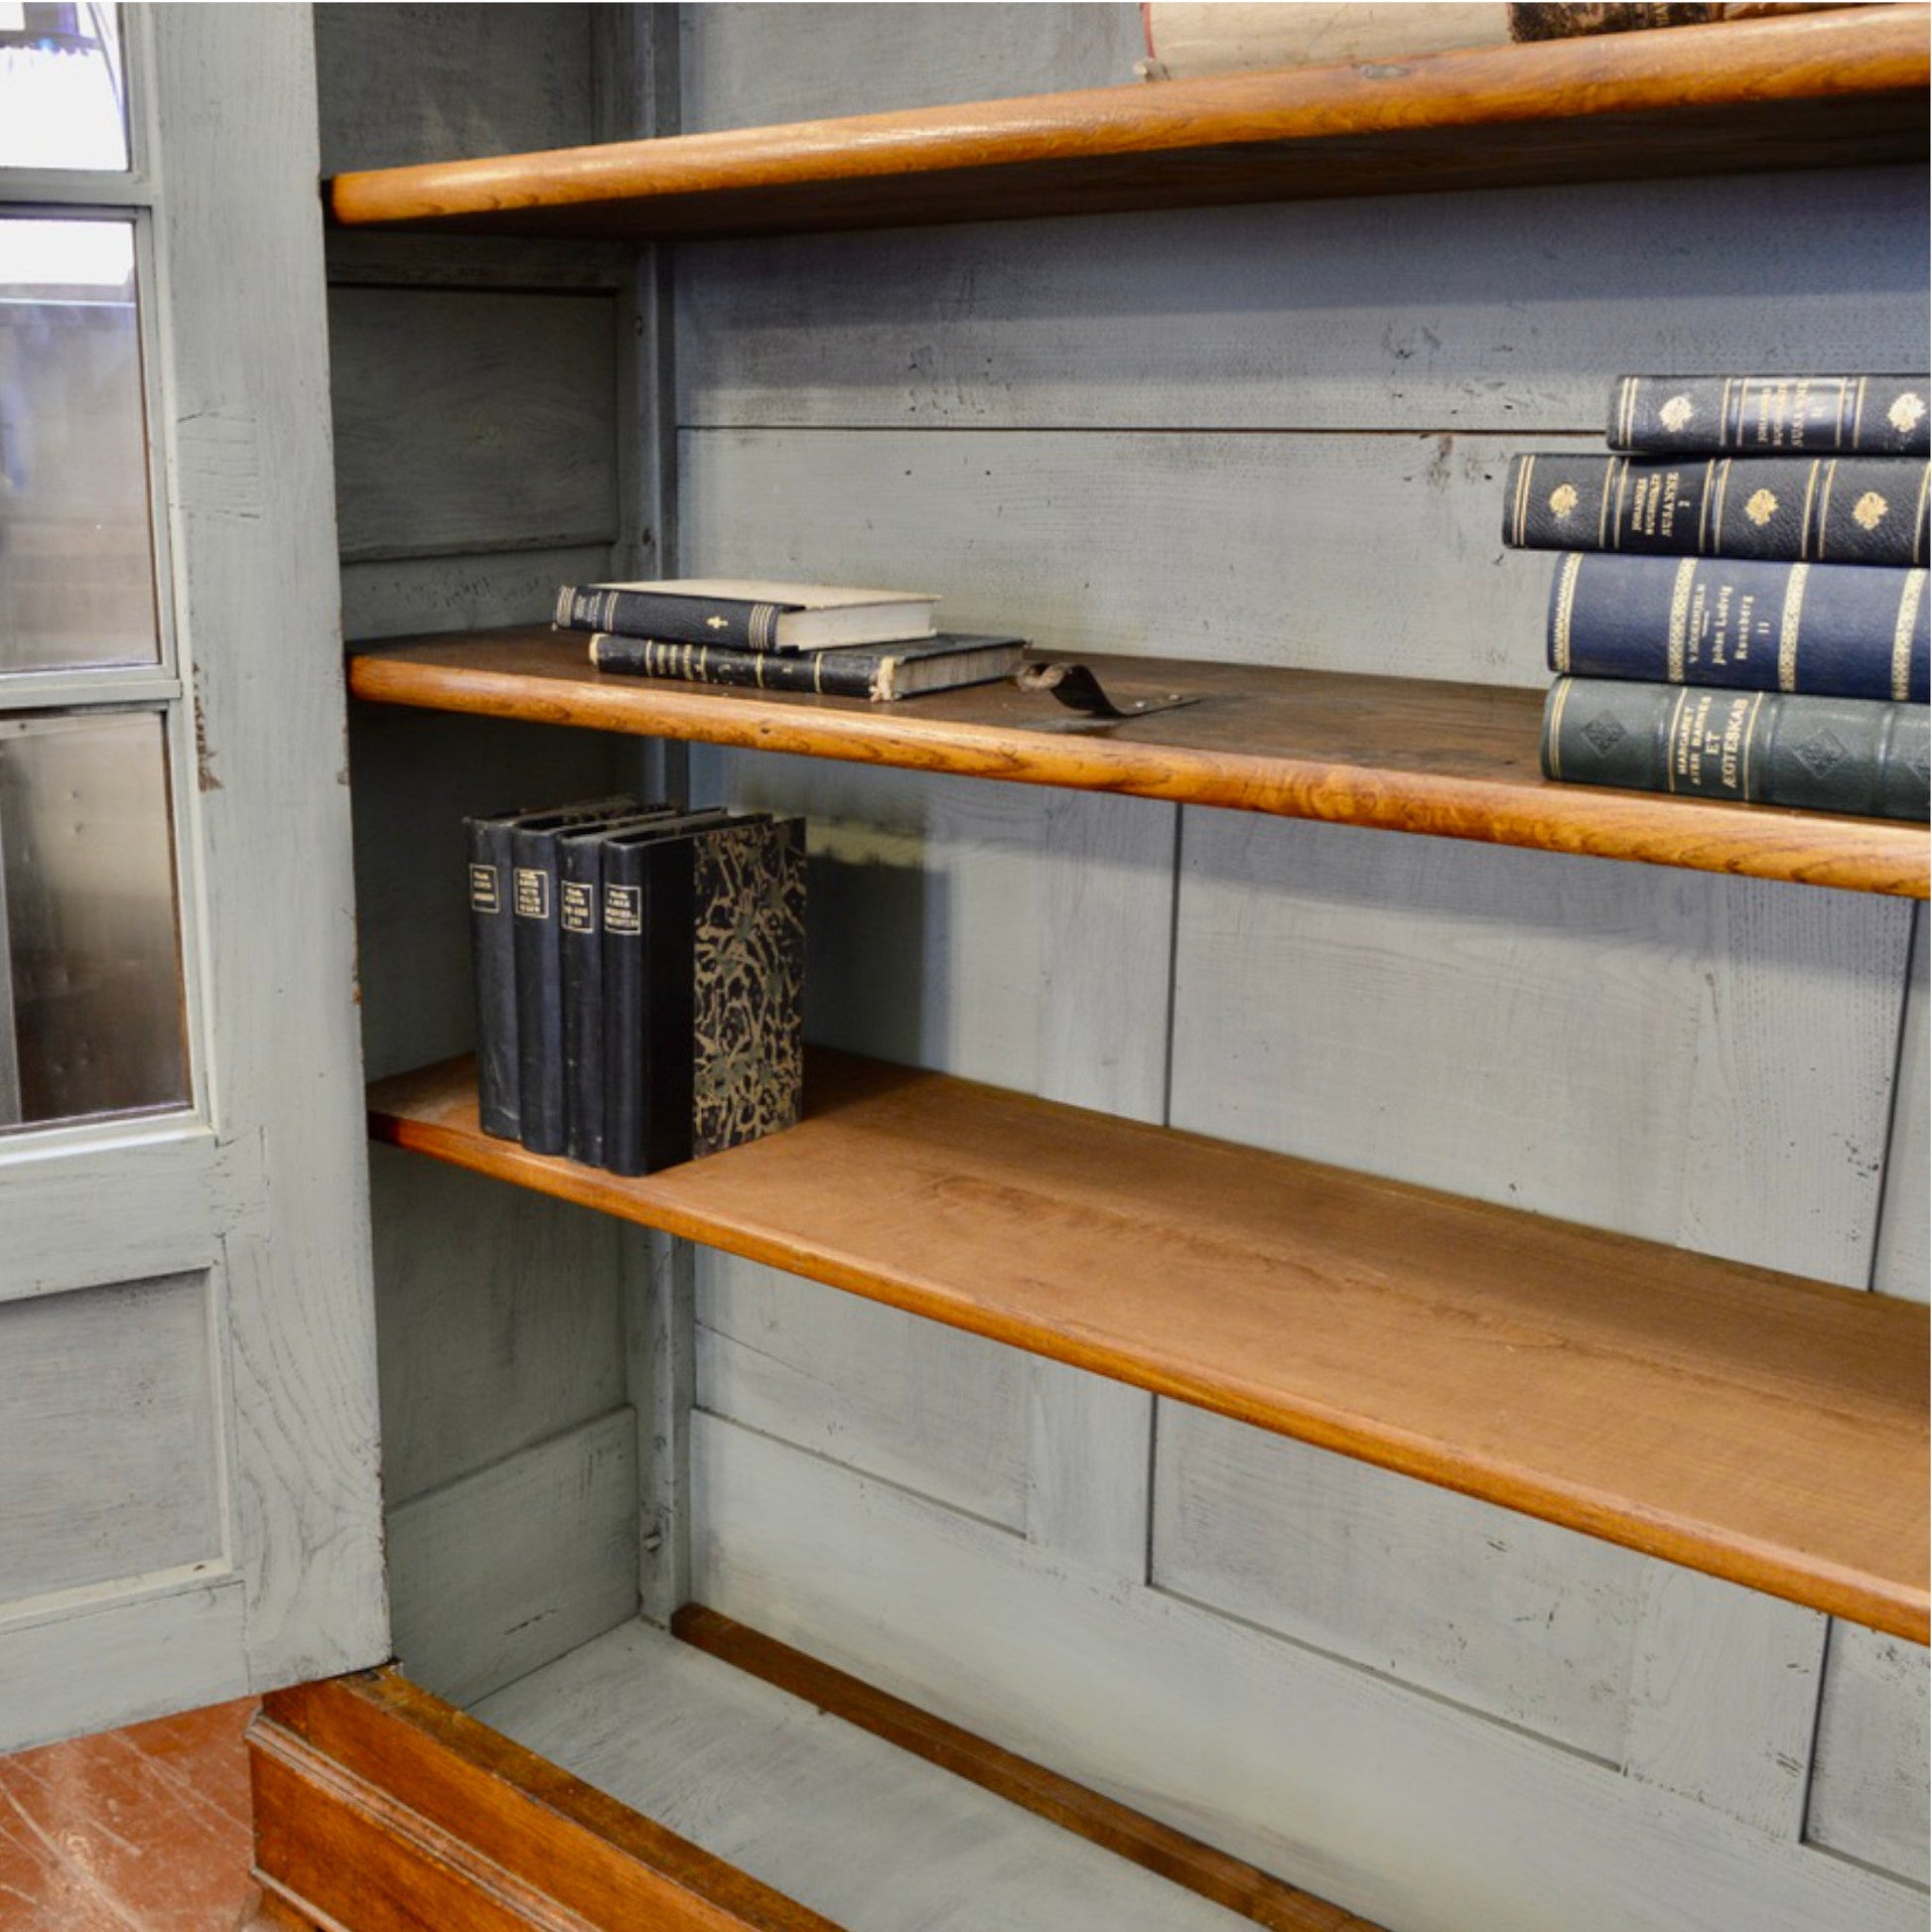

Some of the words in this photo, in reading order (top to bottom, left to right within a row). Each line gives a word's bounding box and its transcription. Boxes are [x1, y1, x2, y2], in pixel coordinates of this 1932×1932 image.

[1661, 471, 1681, 537] SUSANNE
[1676, 706, 1695, 775] MARGARET
[1694, 696, 1713, 748] BARNES
[1705, 731, 1721, 756] ET
